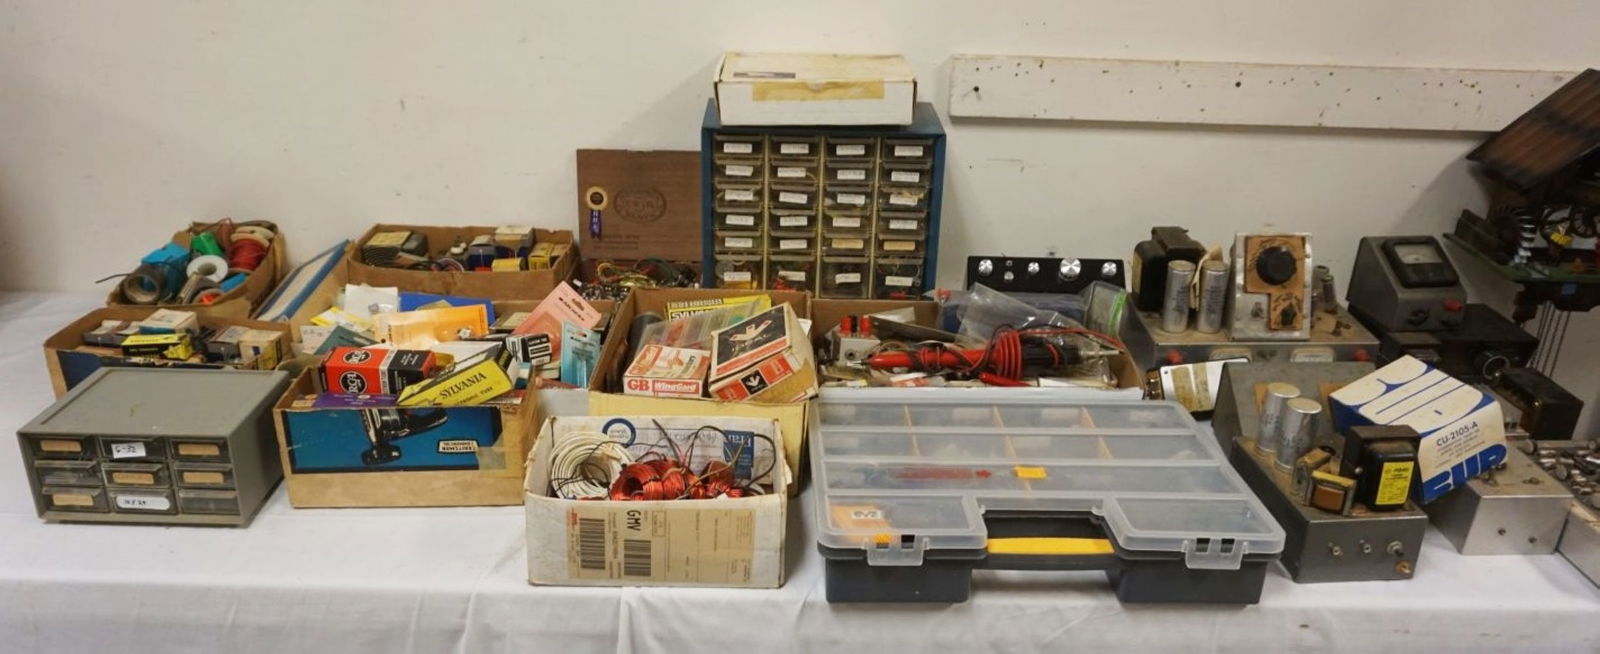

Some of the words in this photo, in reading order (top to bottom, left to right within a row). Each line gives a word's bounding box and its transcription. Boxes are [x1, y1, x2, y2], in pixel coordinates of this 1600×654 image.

[347, 373, 358, 393] RCA
[439, 372, 488, 399] SYLVANIA
[627, 378, 650, 392] GB
[1436, 421, 1479, 447] CU-2105-A
[626, 509, 642, 532] GMV
